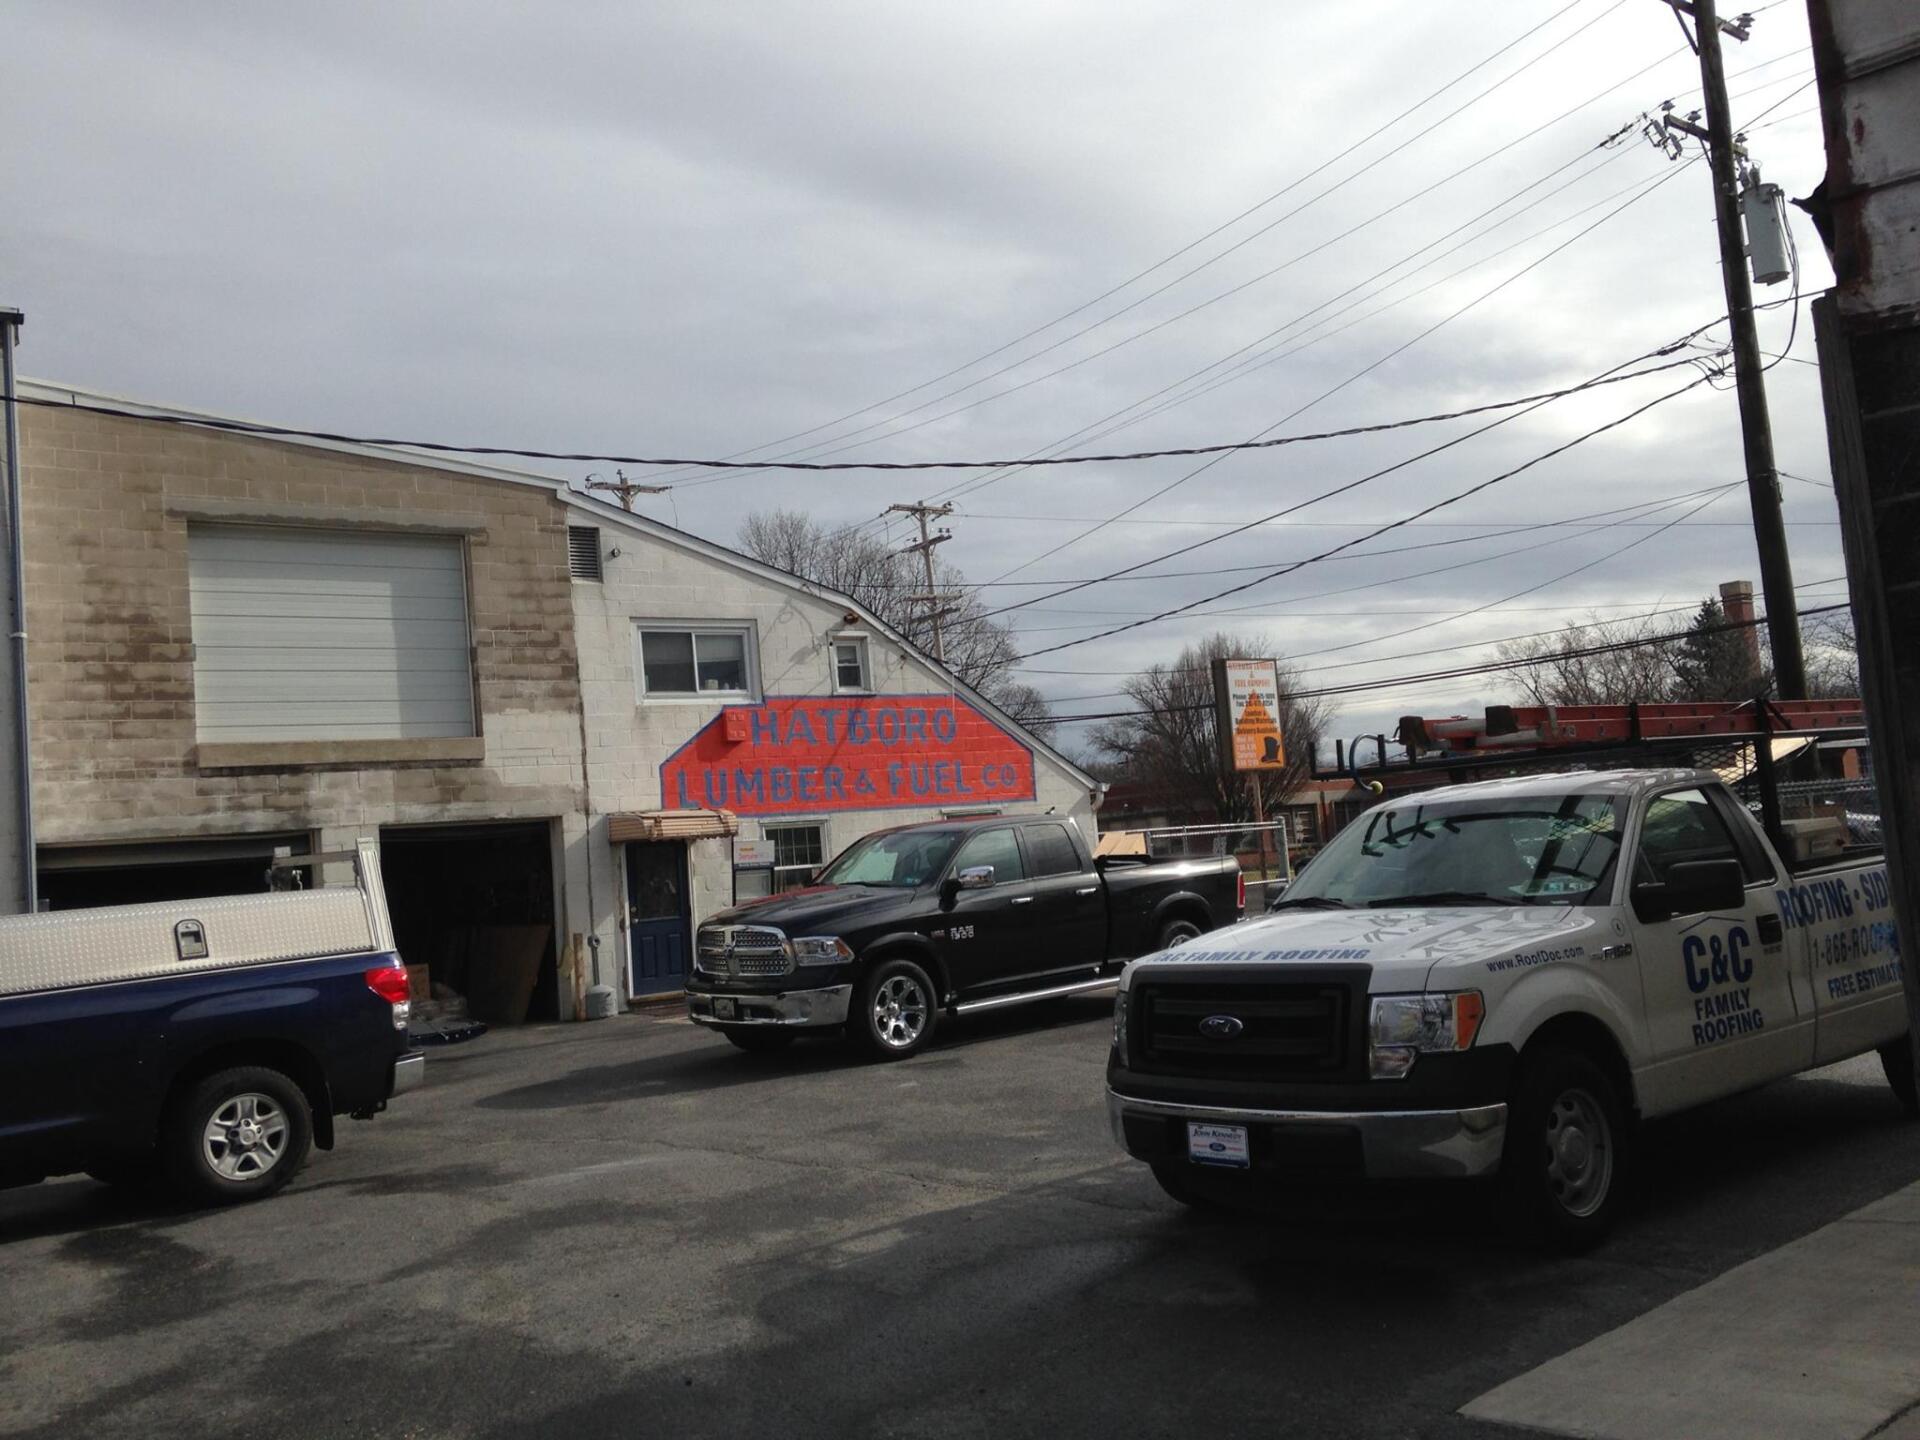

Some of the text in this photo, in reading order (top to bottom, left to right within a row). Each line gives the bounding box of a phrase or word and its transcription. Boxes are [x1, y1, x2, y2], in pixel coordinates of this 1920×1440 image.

[750, 706, 957, 746] HATBORO
[677, 760, 1016, 809] LUMBER & FUEL CO
[1776, 869, 1889, 929] ROOFING SID
[1184, 950, 1260, 962] FAMILY
[1262, 949, 1370, 961] ROOFING
[1682, 926, 1753, 993] C&C
[1695, 988, 1750, 1020] FAMILY
[1827, 974, 1857, 999] FREE
[1692, 1009, 1764, 1046] ROOFING
